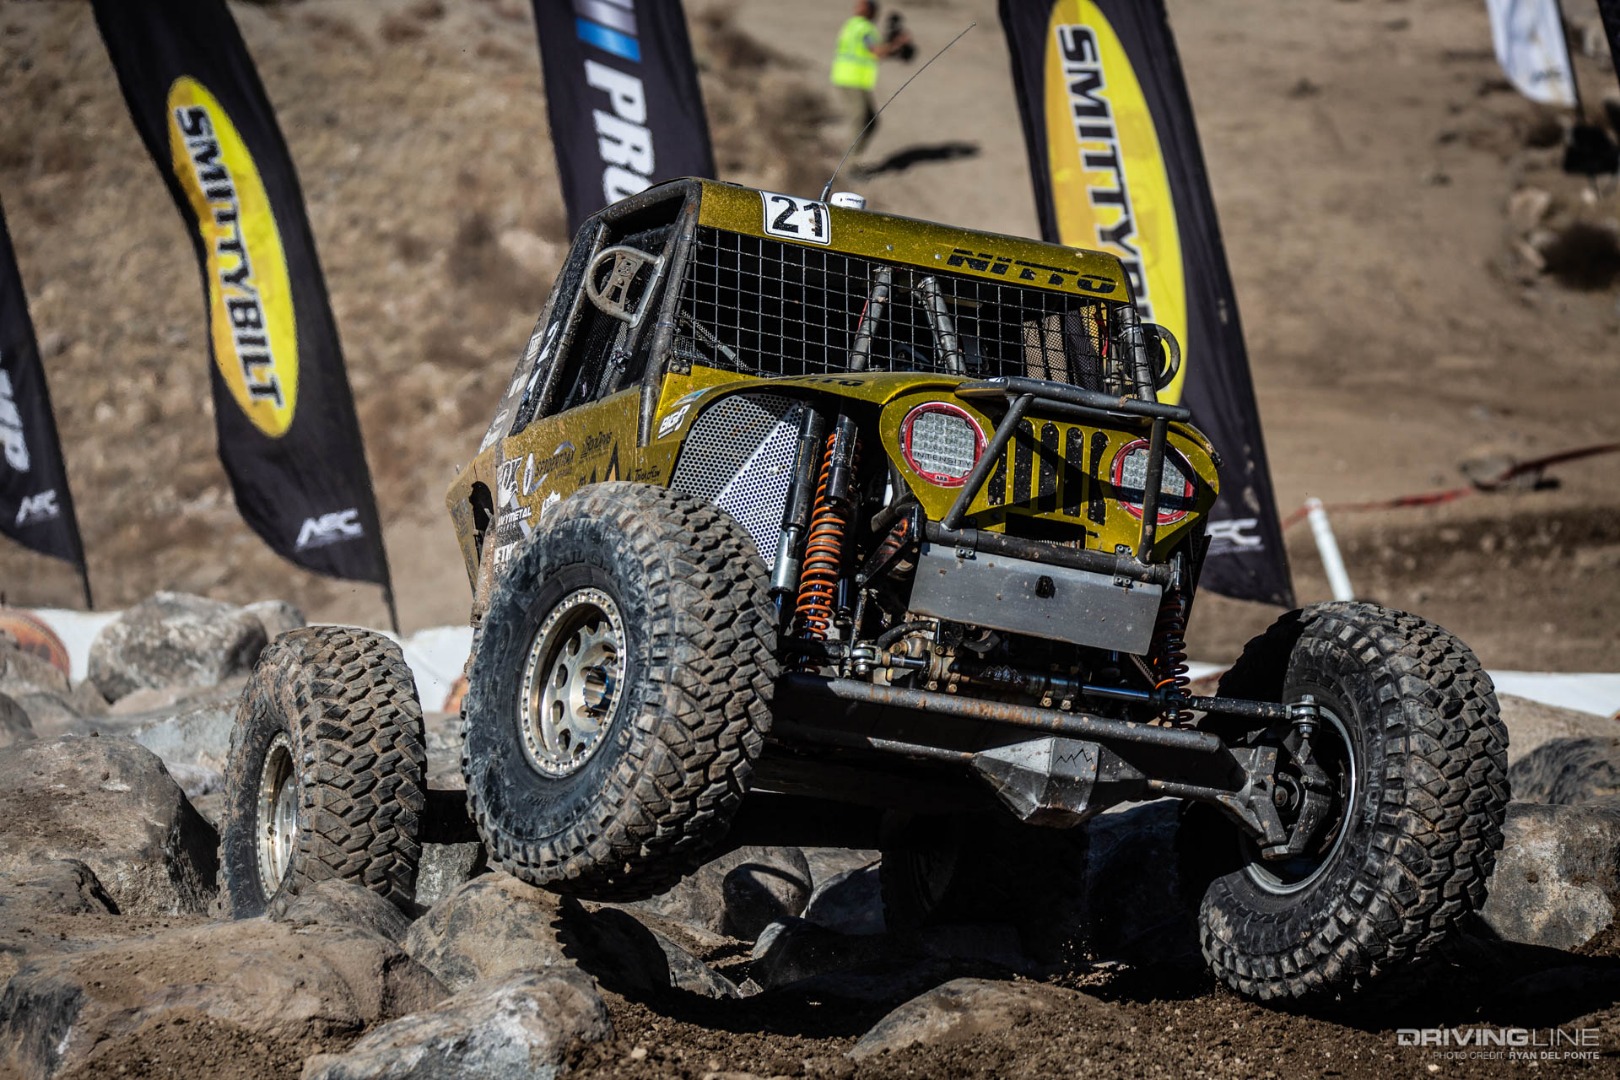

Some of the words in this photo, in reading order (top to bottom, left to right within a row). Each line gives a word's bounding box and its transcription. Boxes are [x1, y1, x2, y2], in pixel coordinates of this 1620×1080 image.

[771, 195, 823, 237] 21
[175, 106, 287, 409] SMITTYBILT
[946, 248, 1117, 294] NITTO
[913, 452, 972, 467] INTENSITY
